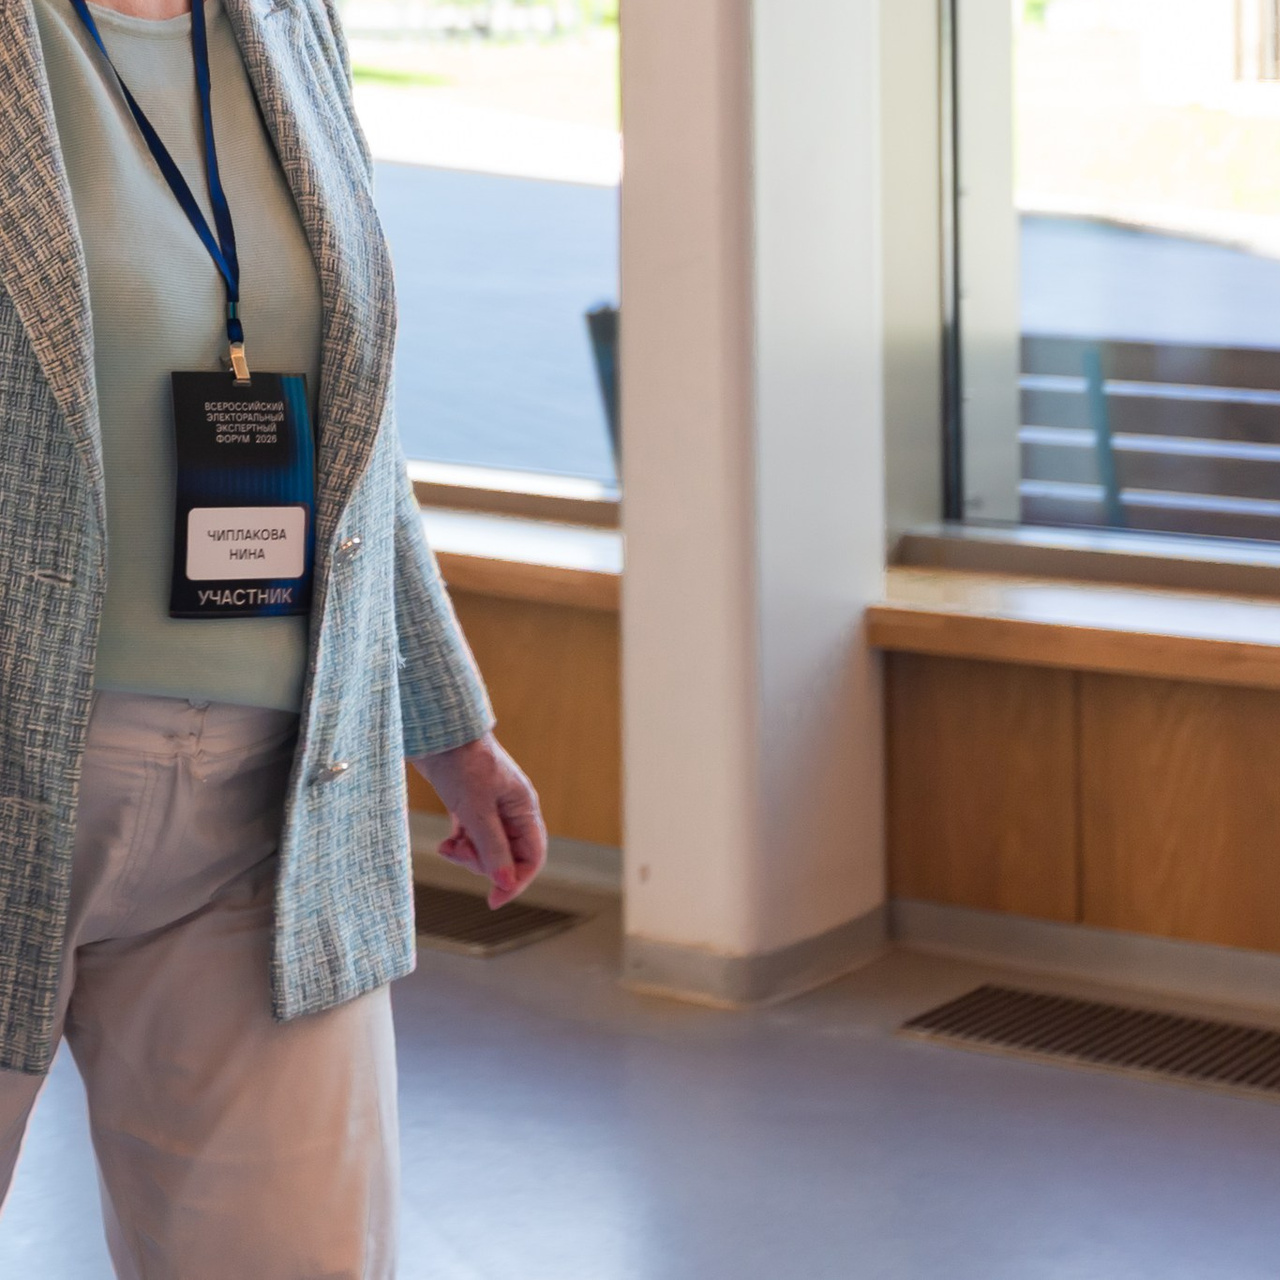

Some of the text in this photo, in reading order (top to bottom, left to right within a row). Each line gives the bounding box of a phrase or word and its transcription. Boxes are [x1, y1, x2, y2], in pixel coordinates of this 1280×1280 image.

[205, 401, 284, 411] ВСЕРОССИЙСКИЙ
[207, 412, 284, 422] ЭЛЕКТОРАЛЬНЫЙ
[216, 423, 277, 433] ЭКСПЕРТНЫЙ
[216, 434, 250, 443] ФОРУМ
[207, 529, 287, 541] ЧИПЛАКОВА
[229, 549, 265, 560] НИНА
[198, 588, 292, 605] УЧАСТНИК
